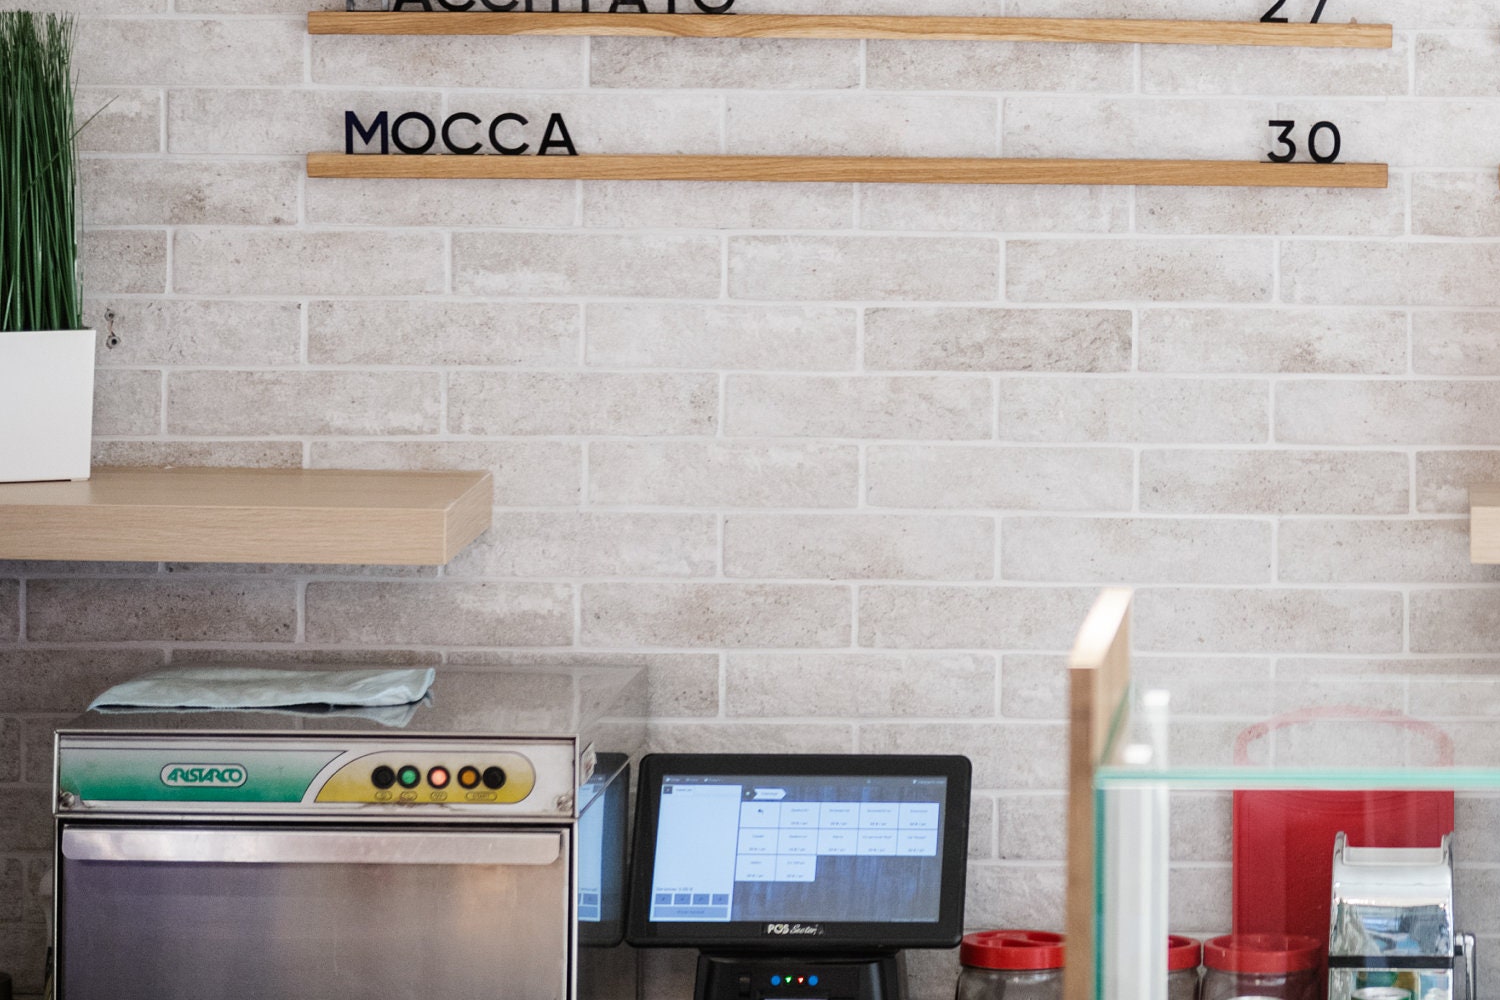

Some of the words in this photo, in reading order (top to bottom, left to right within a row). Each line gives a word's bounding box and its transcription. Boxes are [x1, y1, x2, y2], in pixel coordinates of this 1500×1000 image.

[345, 110, 578, 156] MOCCA
[1267, 120, 1341, 164] 30
[167, 767, 243, 783] ARISTARCO
[767, 923, 789, 935] POS
